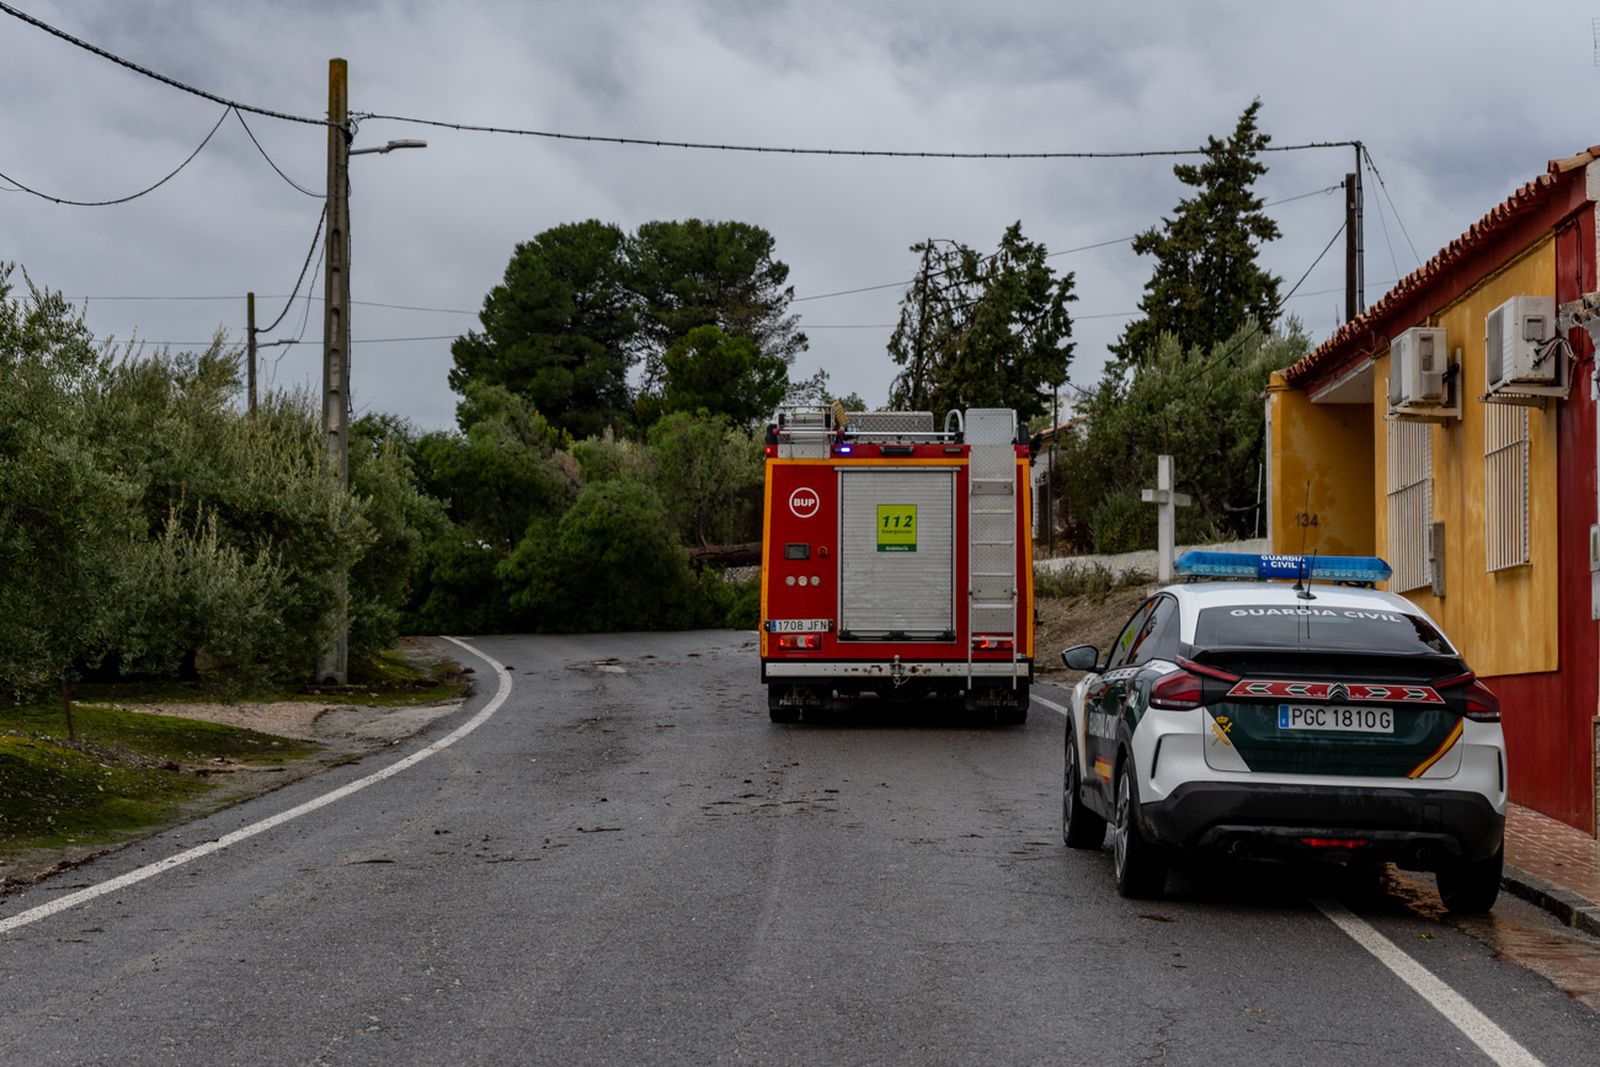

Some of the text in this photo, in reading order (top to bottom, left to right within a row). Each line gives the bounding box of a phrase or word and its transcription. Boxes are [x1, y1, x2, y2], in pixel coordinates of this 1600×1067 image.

[793, 498, 815, 507] BUP
[882, 514, 913, 528] 112
[1295, 512, 1319, 528] 134
[1261, 555, 1306, 563] GUARDIA
[1270, 561, 1298, 569] CIVIL
[1230, 608, 1401, 623] GUARDIA CIVIL
[778, 620, 827, 631] 1708 JFN
[1291, 707, 1327, 727] PGC
